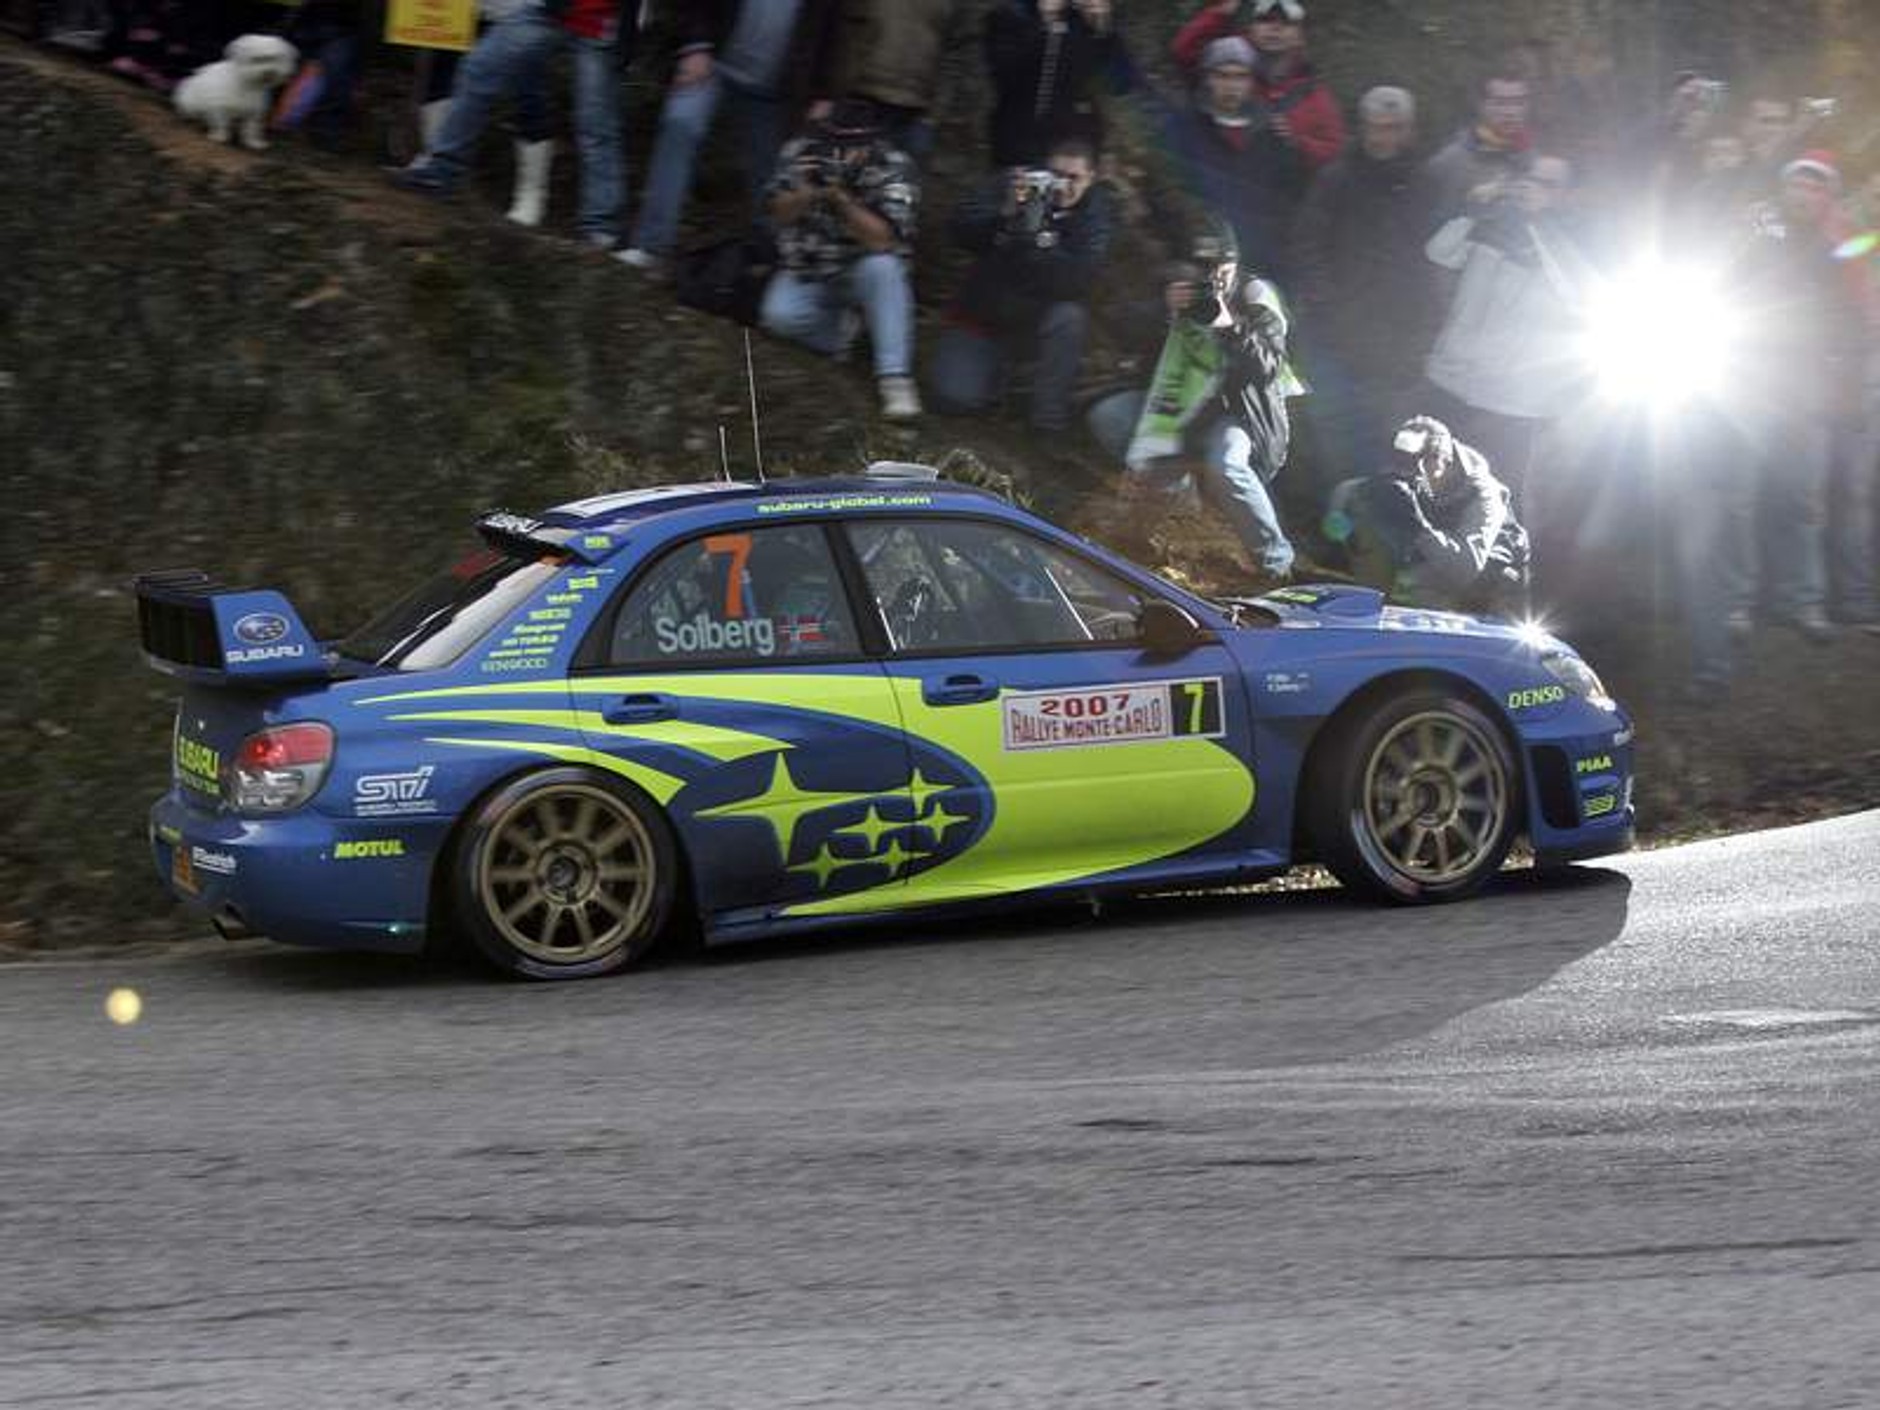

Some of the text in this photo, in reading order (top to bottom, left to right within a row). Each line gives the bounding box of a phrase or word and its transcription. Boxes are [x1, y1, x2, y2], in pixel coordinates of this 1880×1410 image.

[757, 495, 933, 513] subaru-global.com
[703, 534, 753, 617] 7
[656, 614, 774, 655] Solberg
[226, 644, 304, 663] SUBARU
[1041, 694, 1130, 717] 2007
[1184, 684, 1205, 732] 7
[1508, 686, 1565, 708] DENSO
[1011, 708, 1059, 743] RALLYE
[1577, 756, 1613, 772] PIAA
[334, 839, 406, 859] MOTUL
